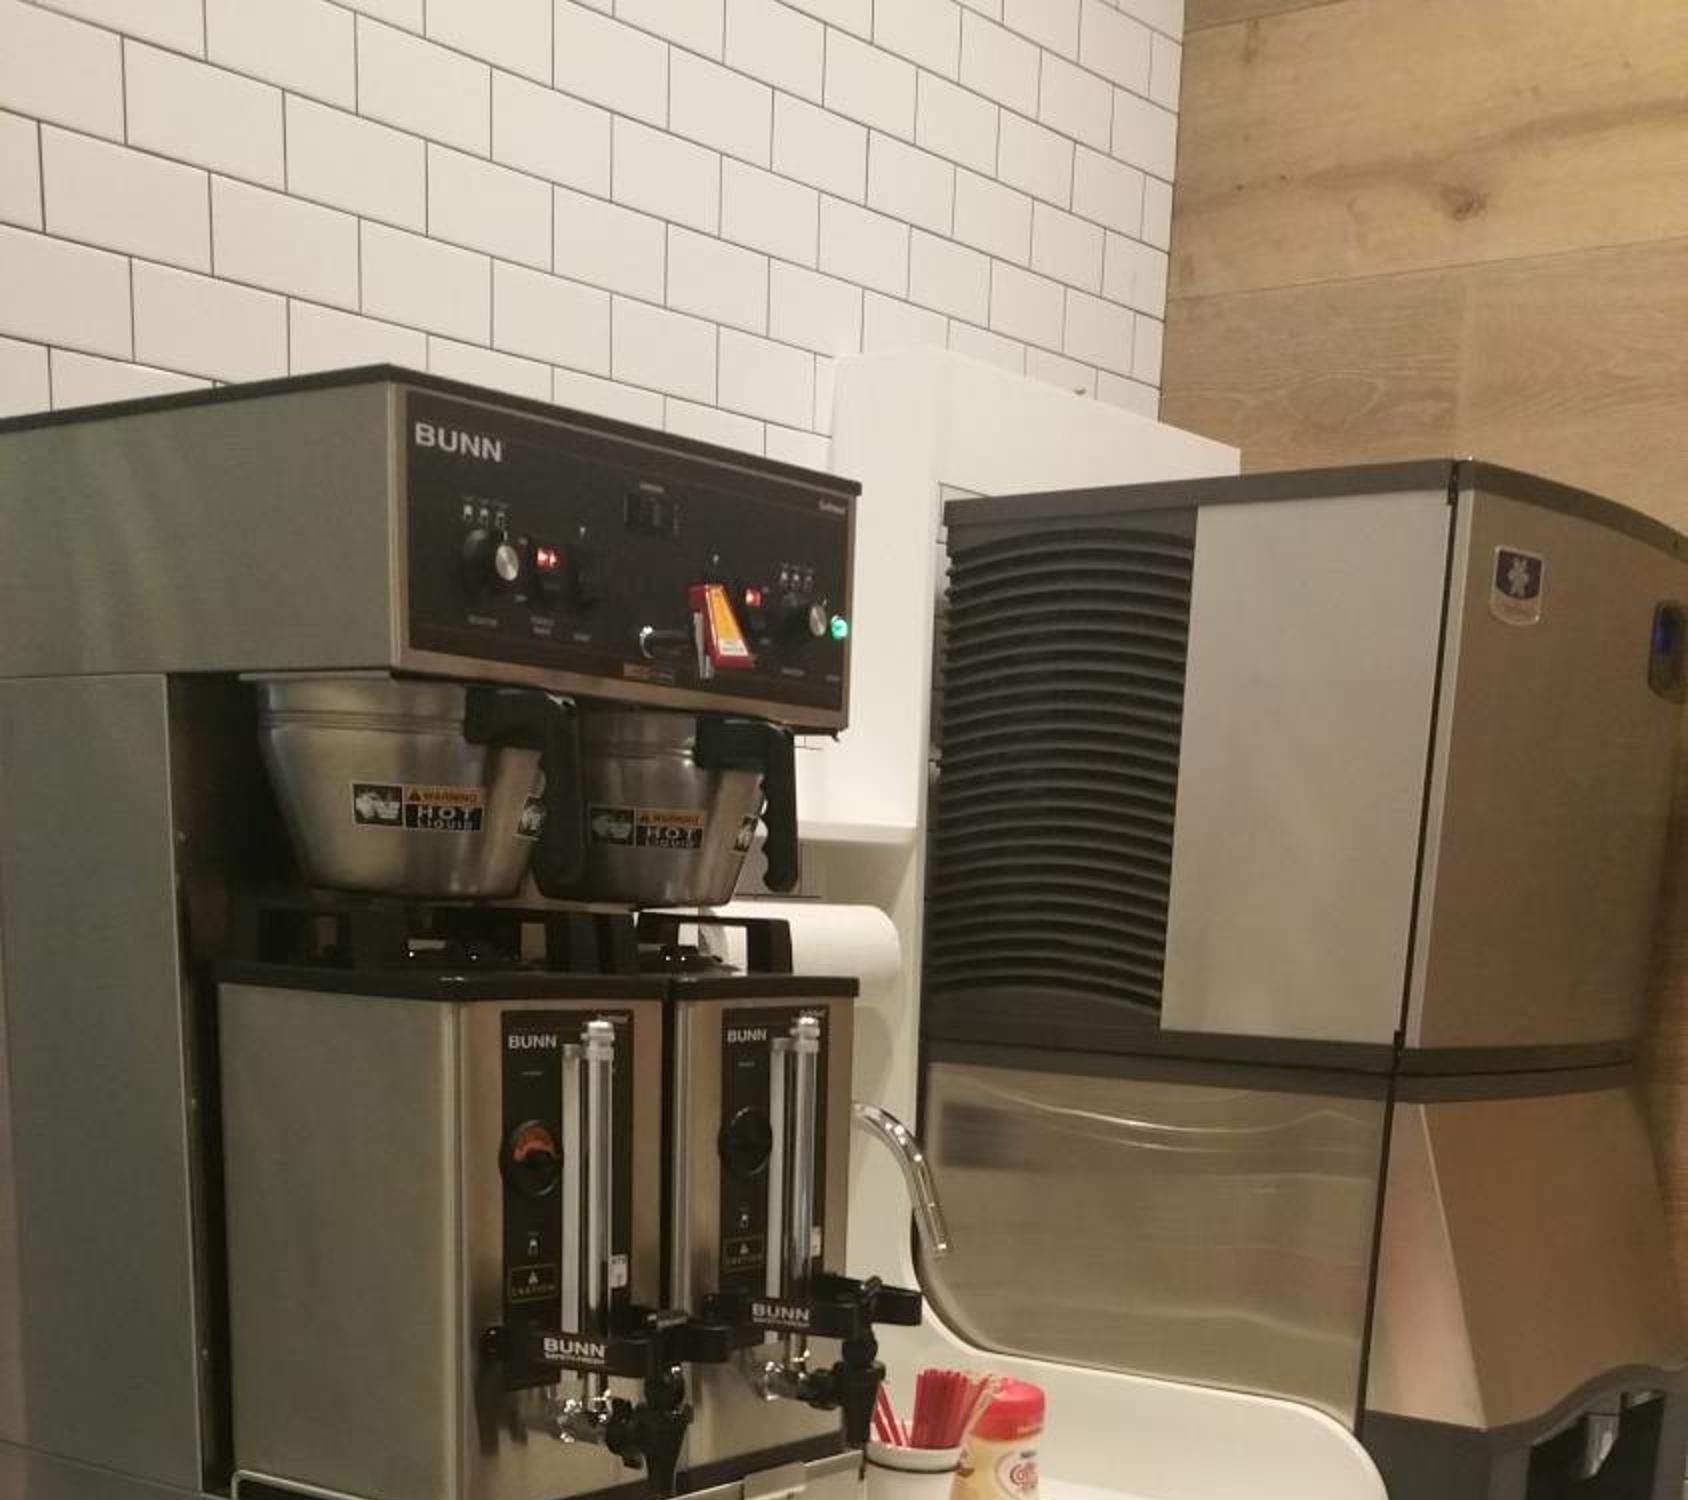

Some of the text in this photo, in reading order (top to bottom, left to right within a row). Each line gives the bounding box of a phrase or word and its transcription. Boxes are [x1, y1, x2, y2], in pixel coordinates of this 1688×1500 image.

[415, 421, 502, 463] BUNN
[417, 804, 475, 820] HOT
[646, 825, 697, 840] HOT
[508, 1034, 558, 1050] BUNN
[727, 1028, 767, 1043] BUNN
[752, 1303, 809, 1322] BUNN
[544, 1337, 606, 1358] BUNN
